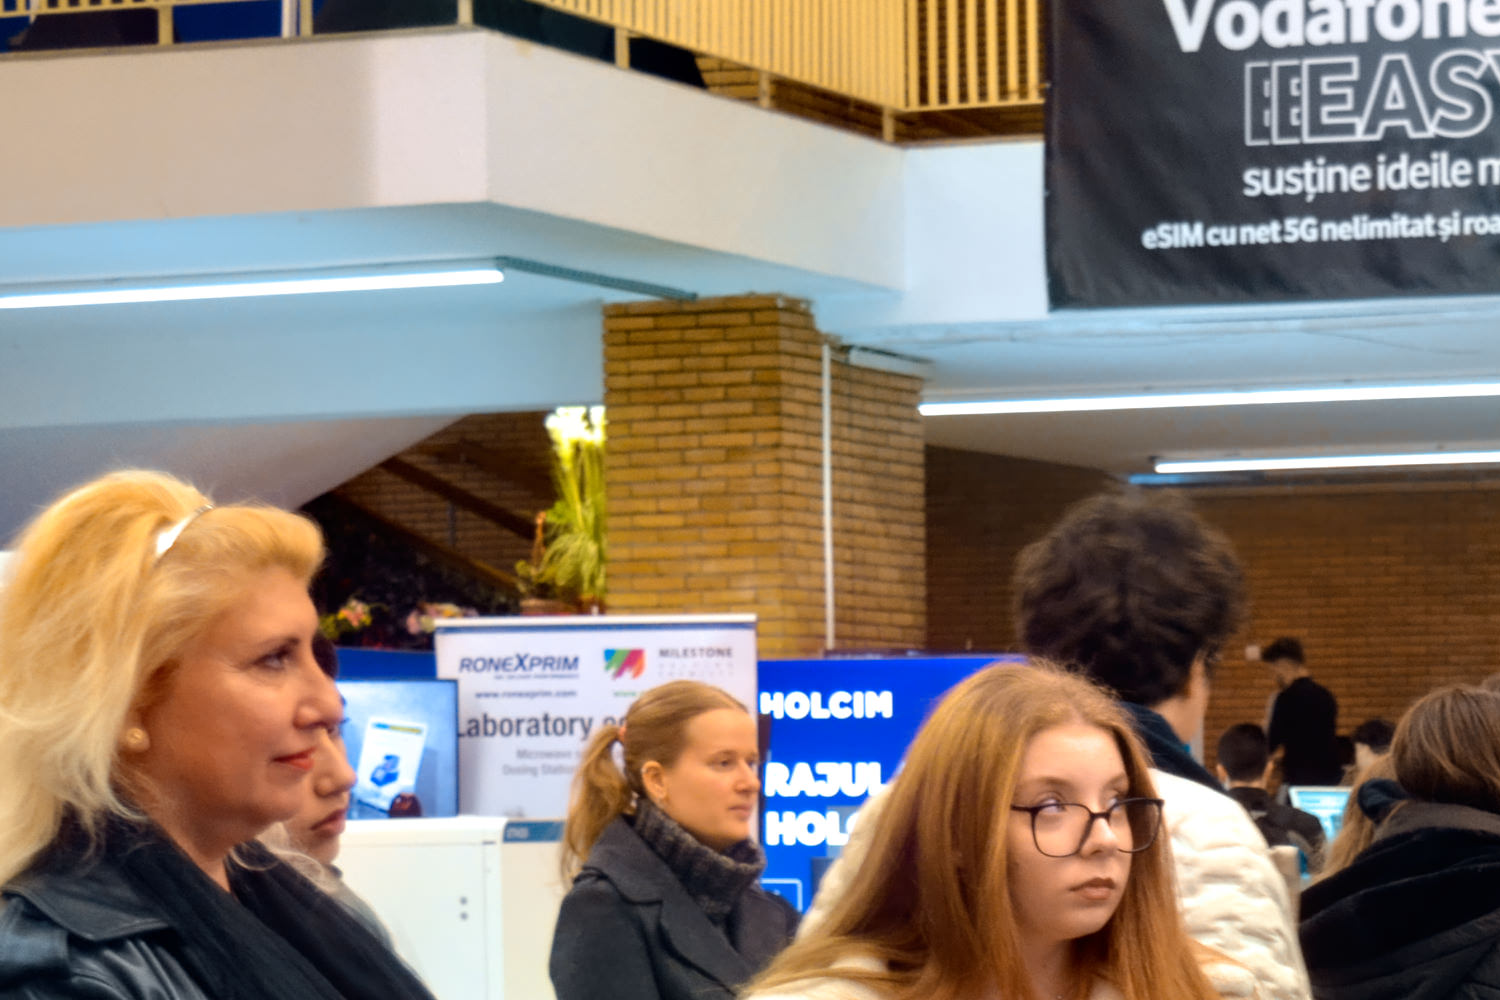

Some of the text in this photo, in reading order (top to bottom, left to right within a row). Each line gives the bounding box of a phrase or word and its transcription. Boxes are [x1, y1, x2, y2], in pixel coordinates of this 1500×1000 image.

[1243, 158, 1371, 202] susține
[1378, 152, 1472, 191] ideile
[1141, 221, 1204, 250] eSIM
[1206, 226, 1236, 246] cu
[1240, 220, 1282, 245] net
[1283, 217, 1318, 242] 5G
[1321, 211, 1435, 242] nelimitat
[760, 690, 893, 720] HOLCIM
[458, 712, 593, 742] aboratory
